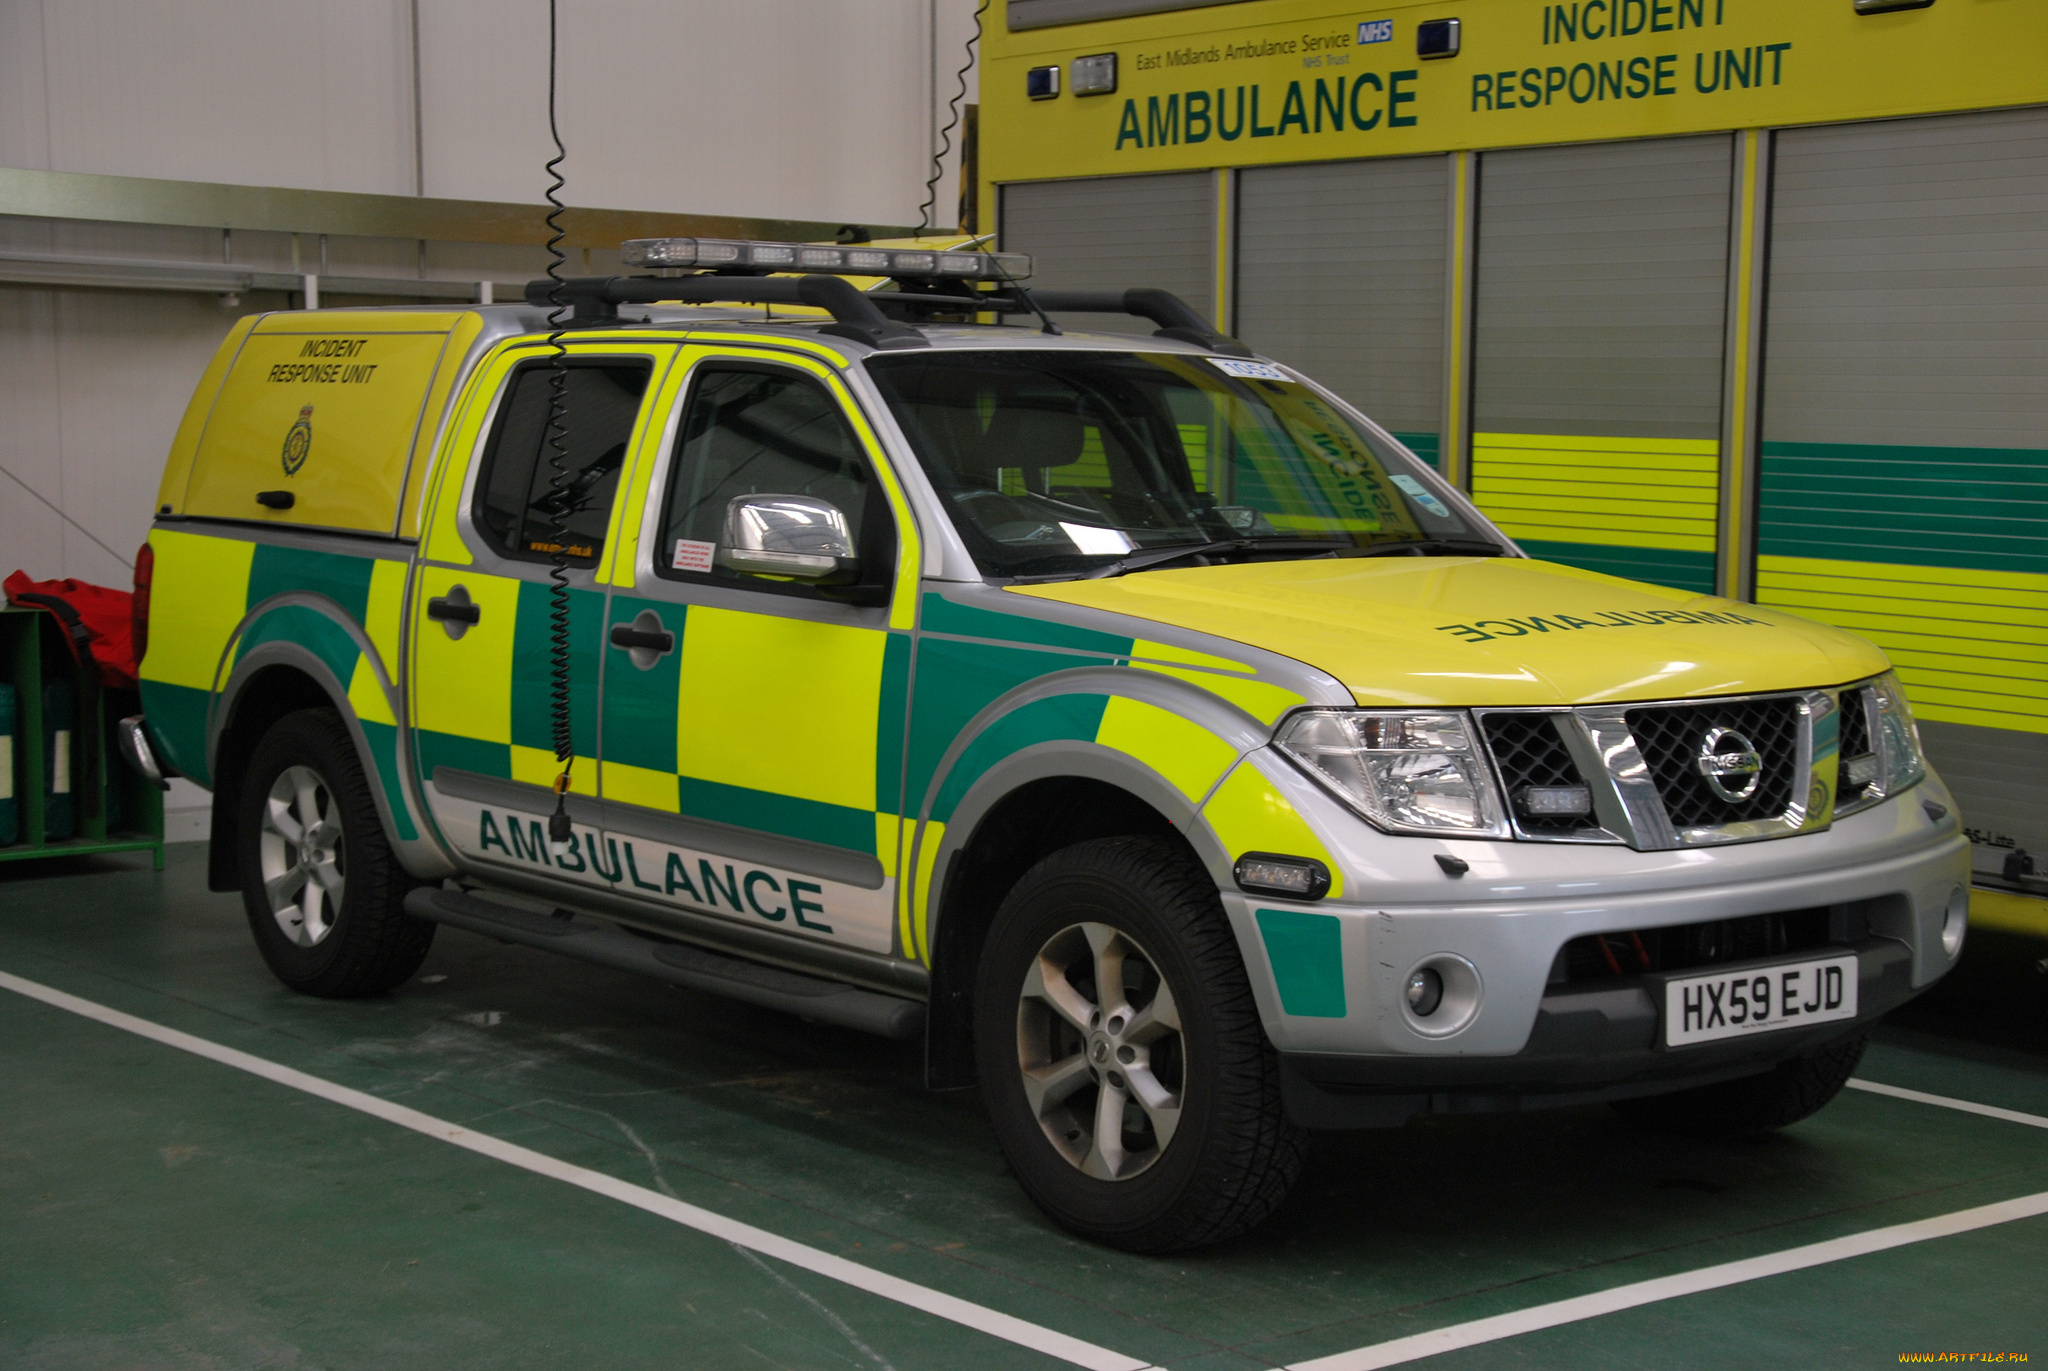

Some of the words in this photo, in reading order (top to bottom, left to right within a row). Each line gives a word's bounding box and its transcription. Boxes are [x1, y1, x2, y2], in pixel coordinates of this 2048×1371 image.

[1136, 53, 1161, 71] East
[1165, 45, 1221, 67] Midlands
[1224, 38, 1297, 60] Ambulance
[1301, 31, 1350, 52] Service
[1358, 20, 1392, 44] NHS
[1302, 55, 1322, 69] NHS
[1326, 53, 1350, 67] Trust
[1471, 54, 1678, 112] RESPONSE
[1695, 42, 1792, 94] UNIT
[1115, 70, 1418, 150] AMBULANCE
[299, 339, 368, 358] INCIDENT
[267, 364, 340, 384] RESPONSE
[341, 364, 378, 384] UNIT
[480, 809, 834, 934] AMBULANCE
[1684, 976, 1770, 1032] HX59
[1781, 966, 1843, 1018] EJD
